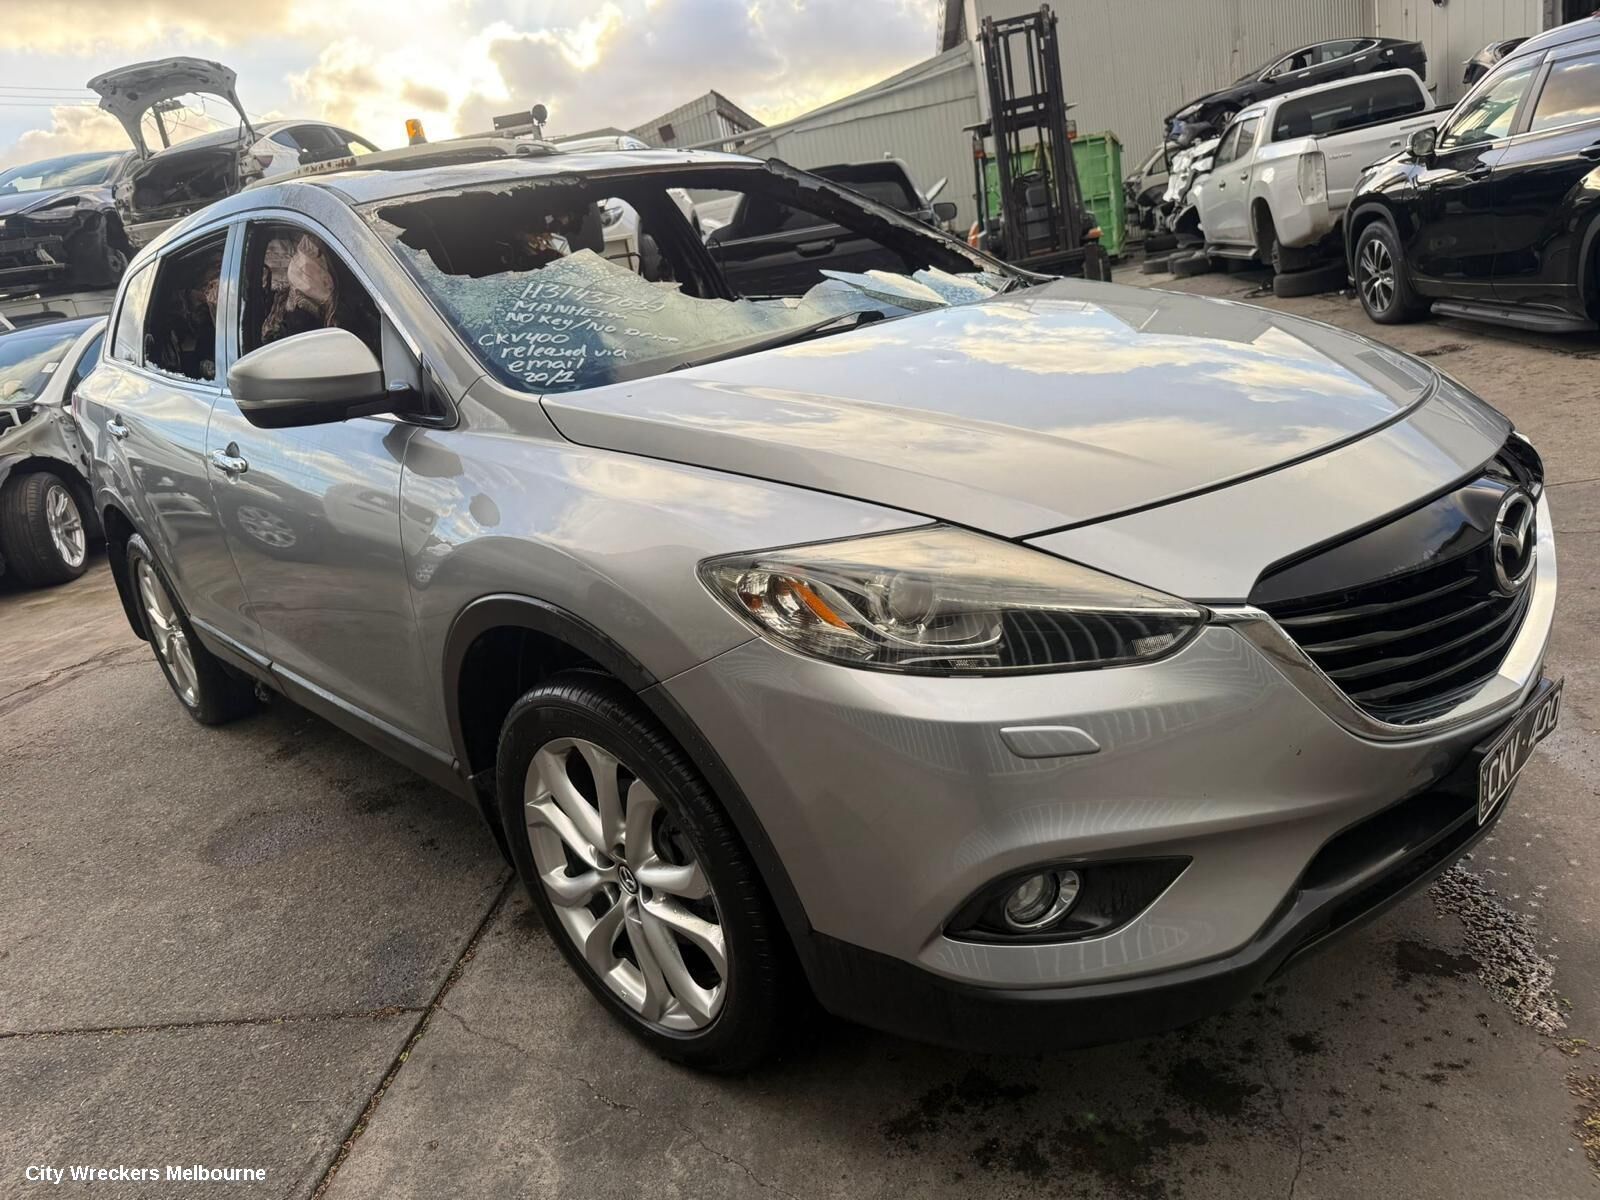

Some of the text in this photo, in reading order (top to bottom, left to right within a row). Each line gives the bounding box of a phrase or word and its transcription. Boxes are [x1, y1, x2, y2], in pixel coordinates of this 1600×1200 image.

[478, 331, 570, 347] CKV400
[501, 344, 628, 360] released via
[508, 358, 585, 373] email
